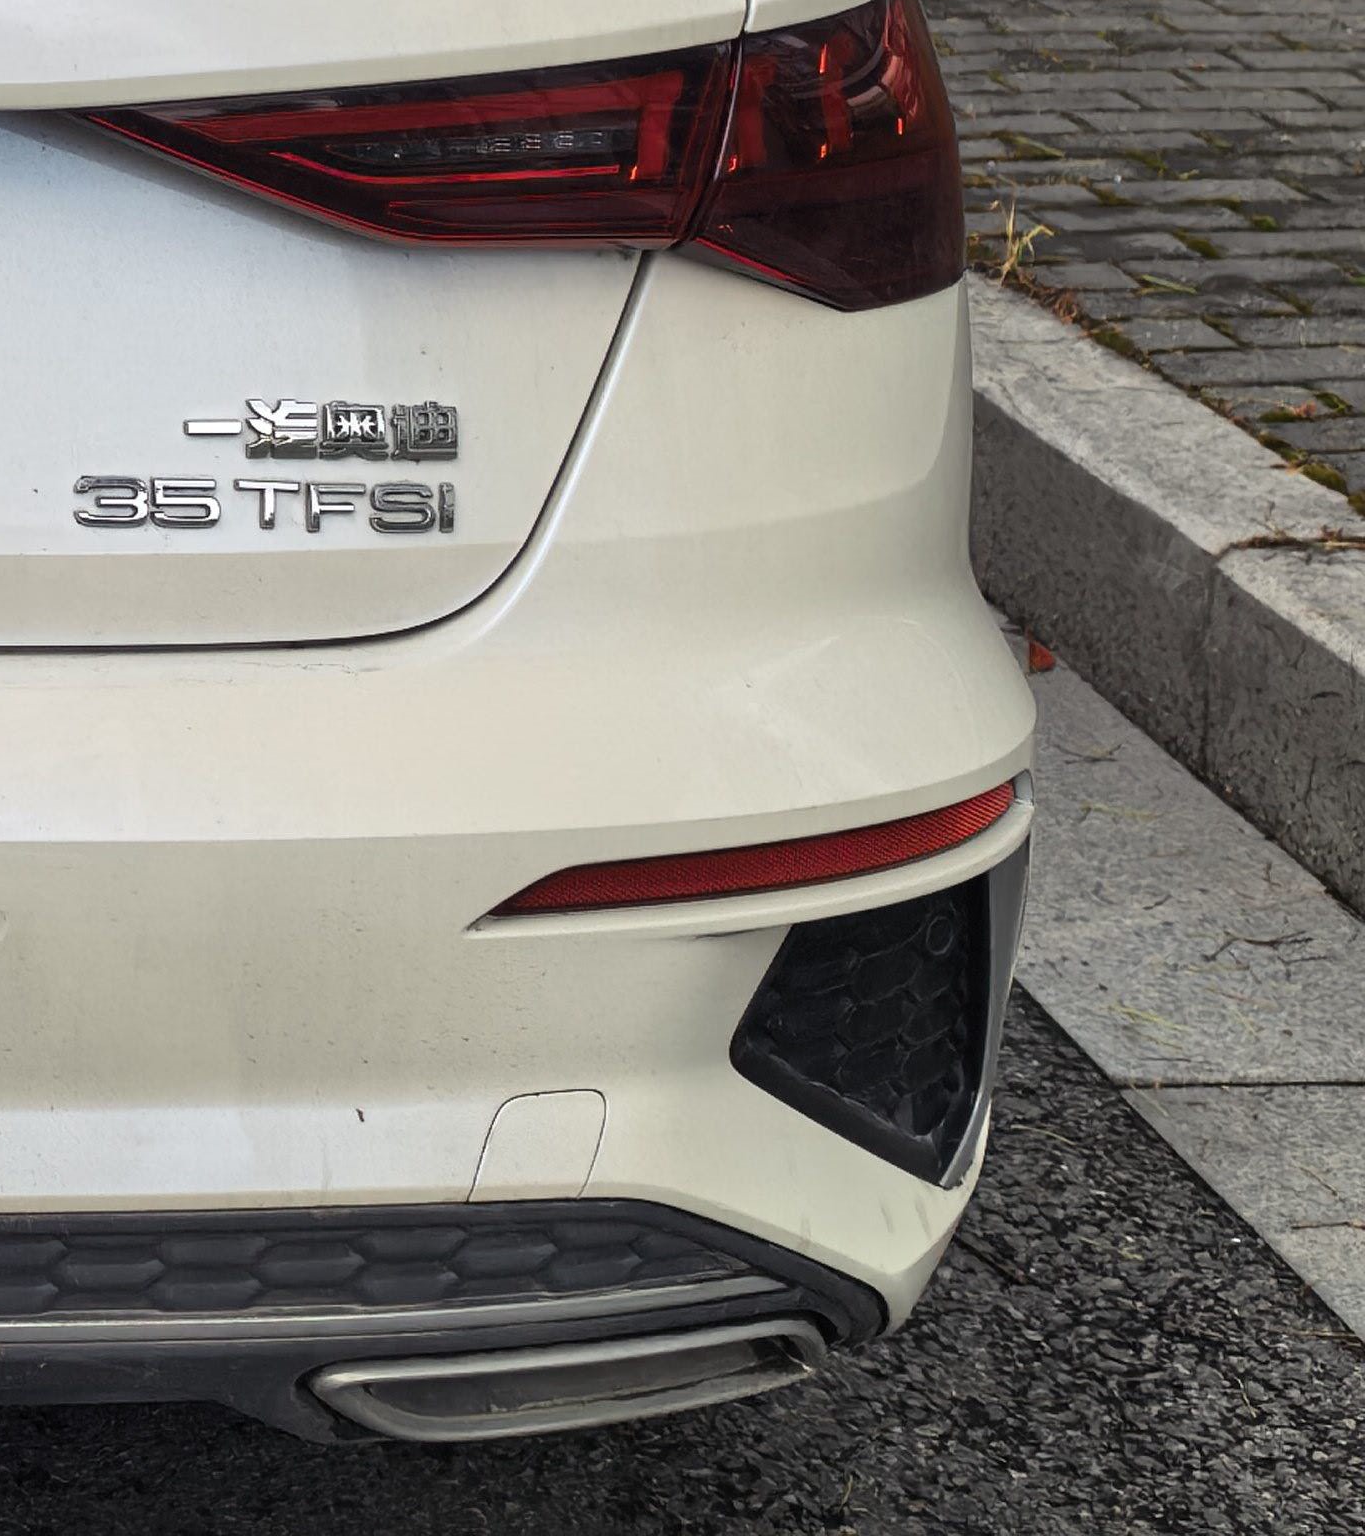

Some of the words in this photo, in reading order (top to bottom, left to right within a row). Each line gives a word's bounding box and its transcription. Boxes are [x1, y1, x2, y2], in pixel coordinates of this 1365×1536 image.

[183, 398, 459, 461] 一汽奥迪
[73, 475, 221, 529] 35
